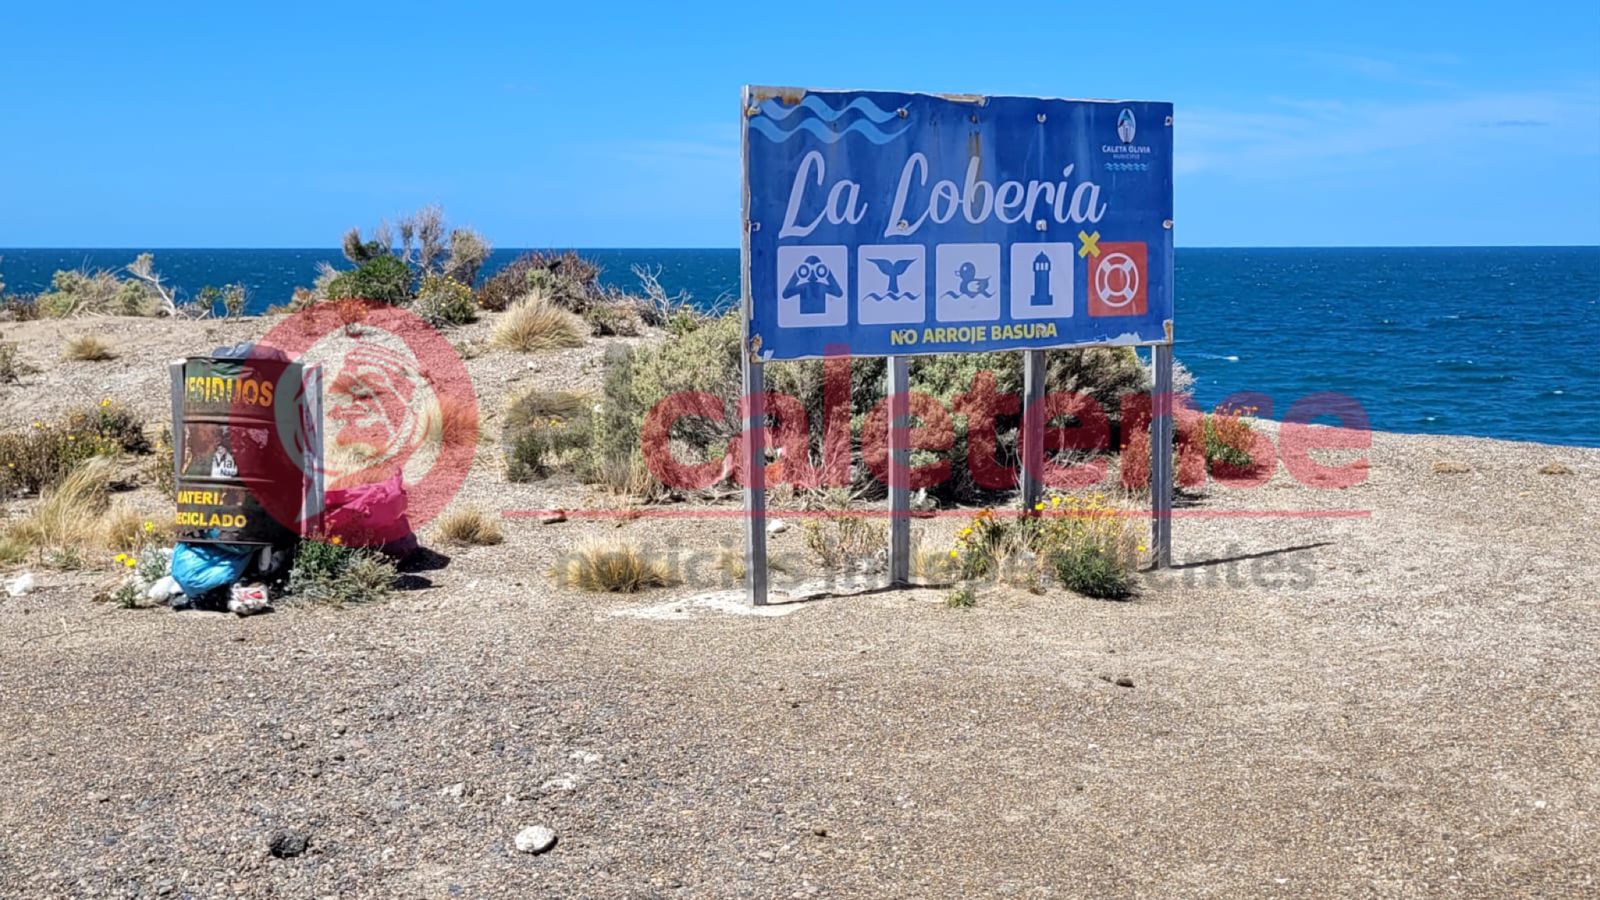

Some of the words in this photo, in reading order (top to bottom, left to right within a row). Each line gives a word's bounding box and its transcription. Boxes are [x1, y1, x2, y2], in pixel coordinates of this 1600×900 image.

[1102, 145, 1127, 153] CALETA
[1128, 145, 1151, 154] OLIVIA
[778, 150, 867, 239] La
[884, 152, 1107, 239] Lobería
[890, 330, 917, 345] NO
[922, 327, 986, 345] ARROJE
[991, 323, 1057, 340] BASURA
[176, 511, 247, 528] ECICLADO
